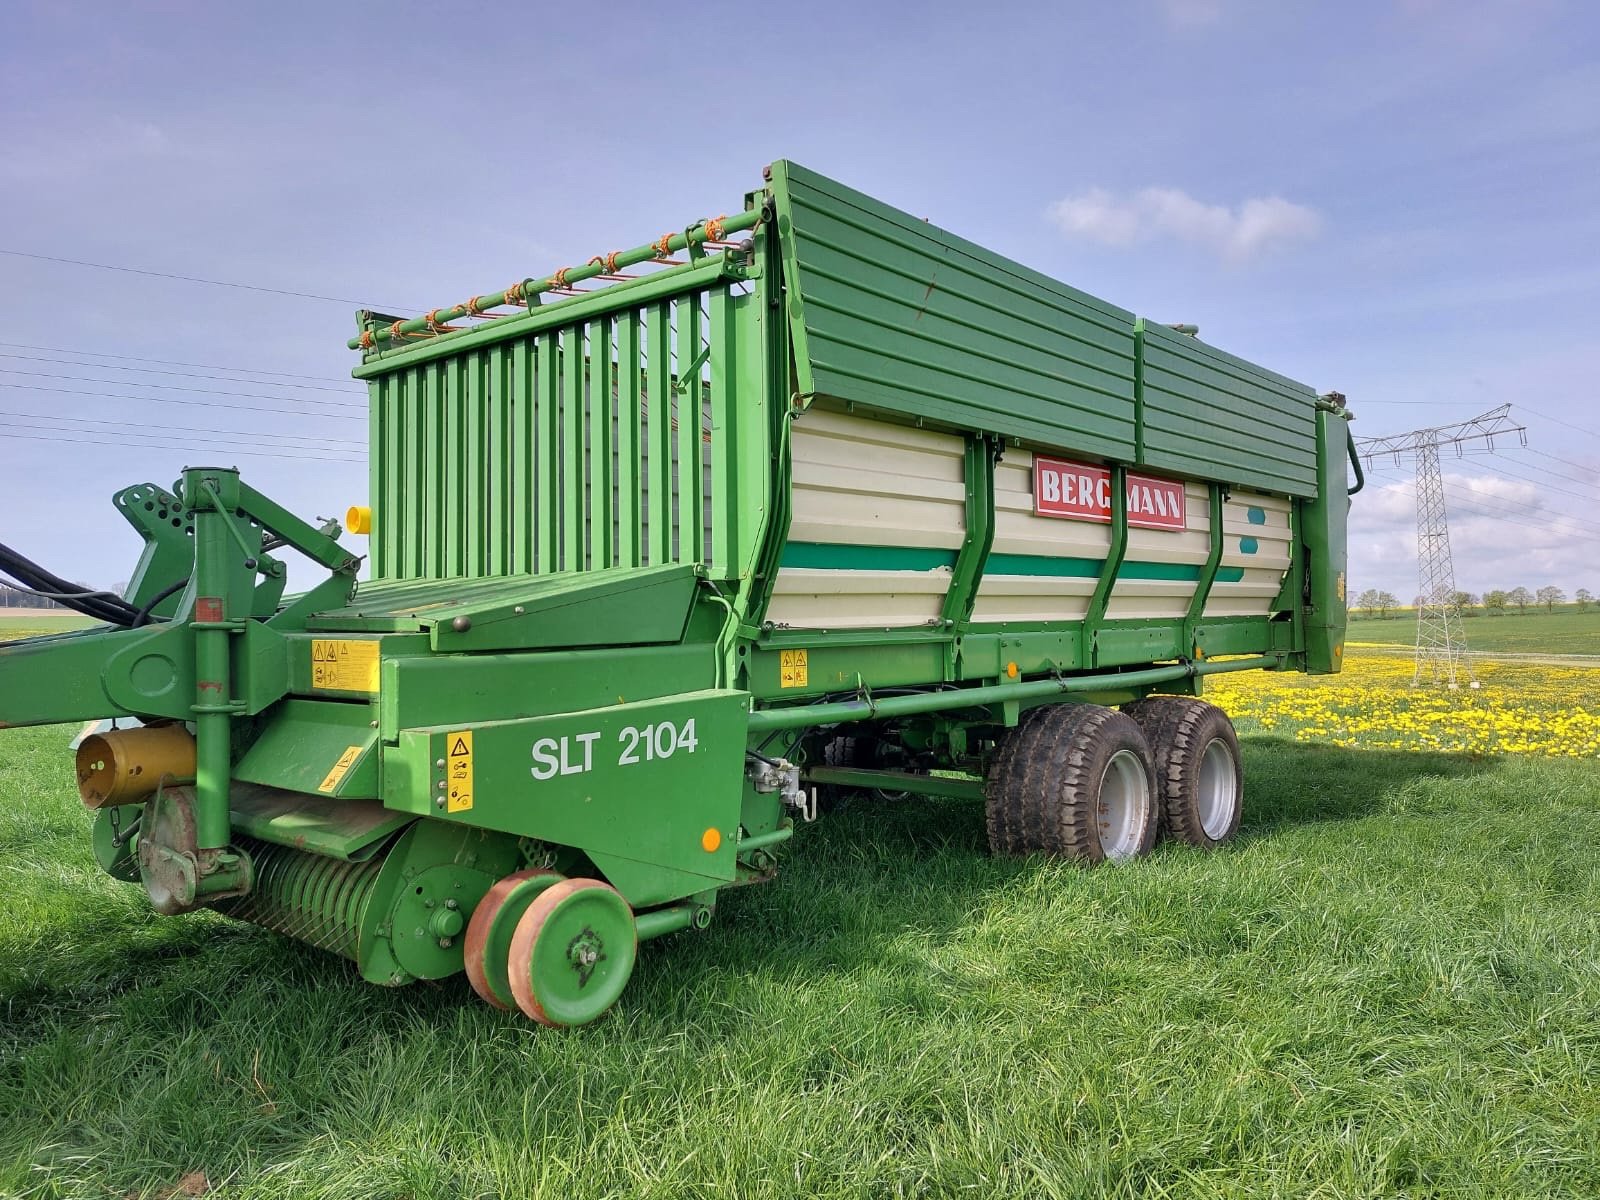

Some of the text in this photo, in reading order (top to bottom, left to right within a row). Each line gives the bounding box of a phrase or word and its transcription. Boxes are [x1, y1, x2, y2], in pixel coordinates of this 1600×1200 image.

[1041, 469, 1181, 519] BERGMANN
[531, 718, 699, 780] SLT 2104
